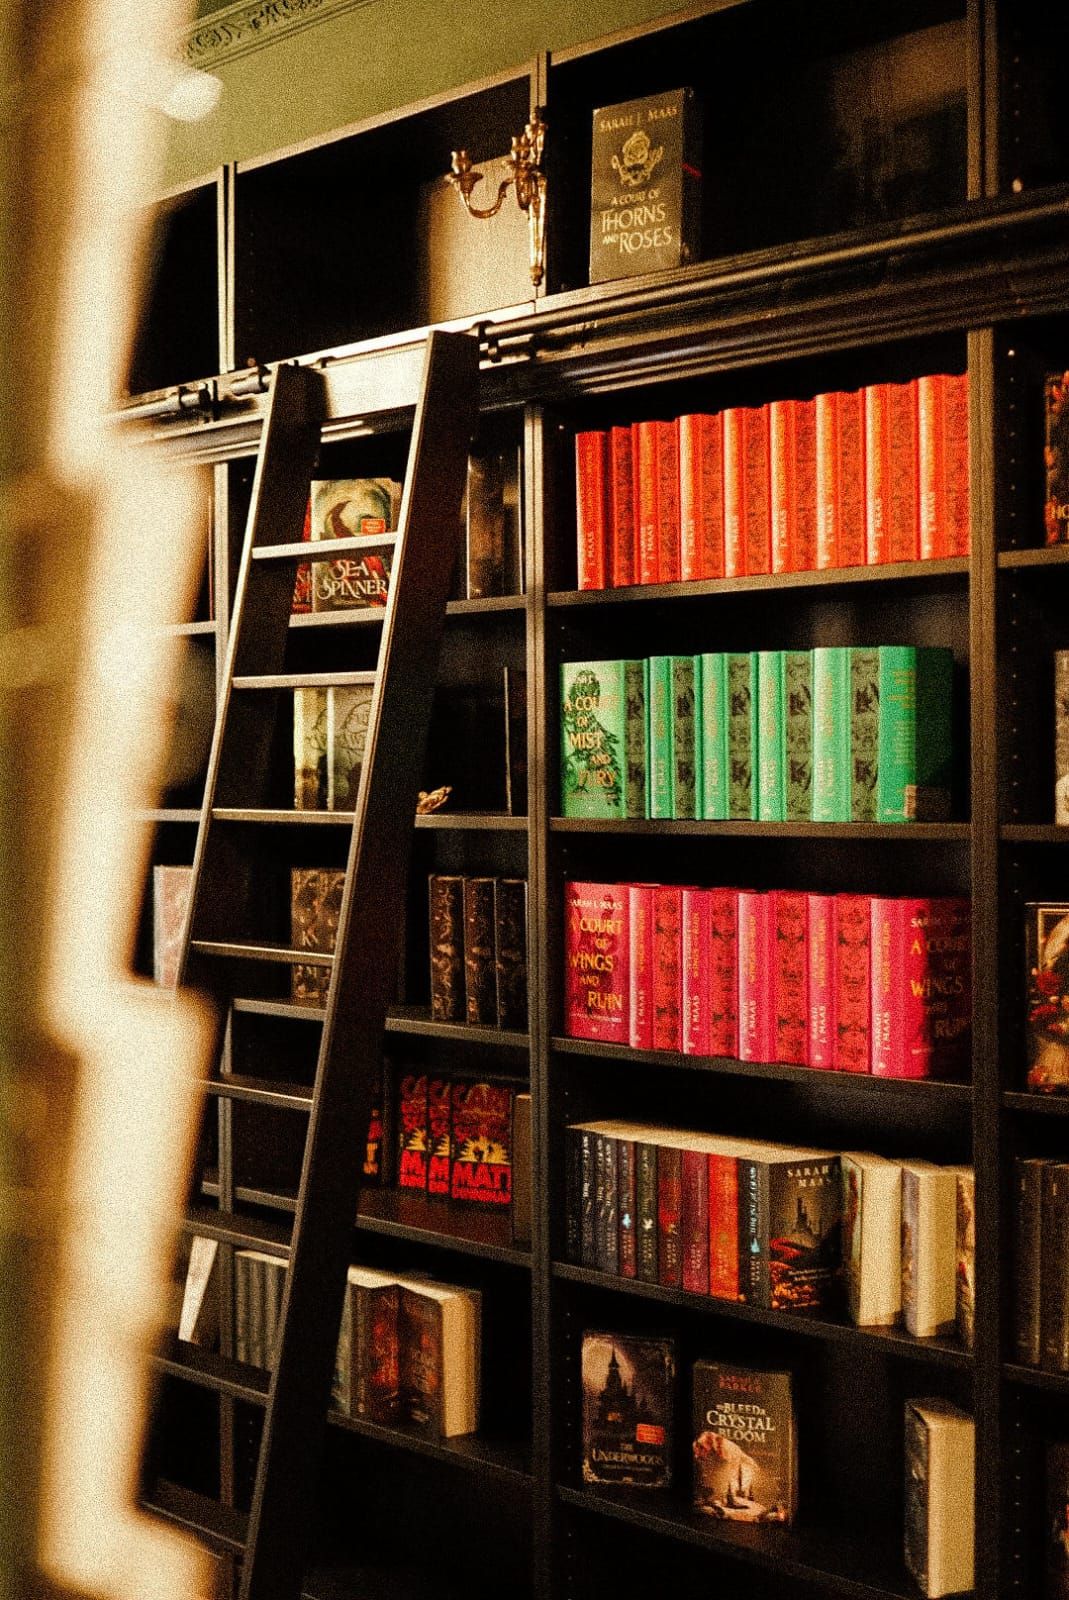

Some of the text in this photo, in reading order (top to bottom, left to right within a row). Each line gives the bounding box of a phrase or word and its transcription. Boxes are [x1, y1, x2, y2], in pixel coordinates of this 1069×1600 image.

[599, 116, 632, 132] SARAH
[647, 106, 676, 120] MAAS
[599, 203, 665, 233] THORNS
[618, 226, 671, 253] ROSES
[331, 559, 369, 580] SEA
[317, 579, 388, 600] SPINNER
[571, 732, 603, 750] MIST
[590, 753, 612, 766] AND
[580, 917, 623, 935] COURT
[569, 952, 614, 973] WINGS
[580, 975, 599, 988] AND
[588, 990, 623, 1011] RUIN
[786, 1165, 829, 1178] SARAH
[723, 1402, 760, 1415] BLEED
[706, 1410, 775, 1432] CRYSTAL
[718, 1427, 766, 1443] BLOOM
